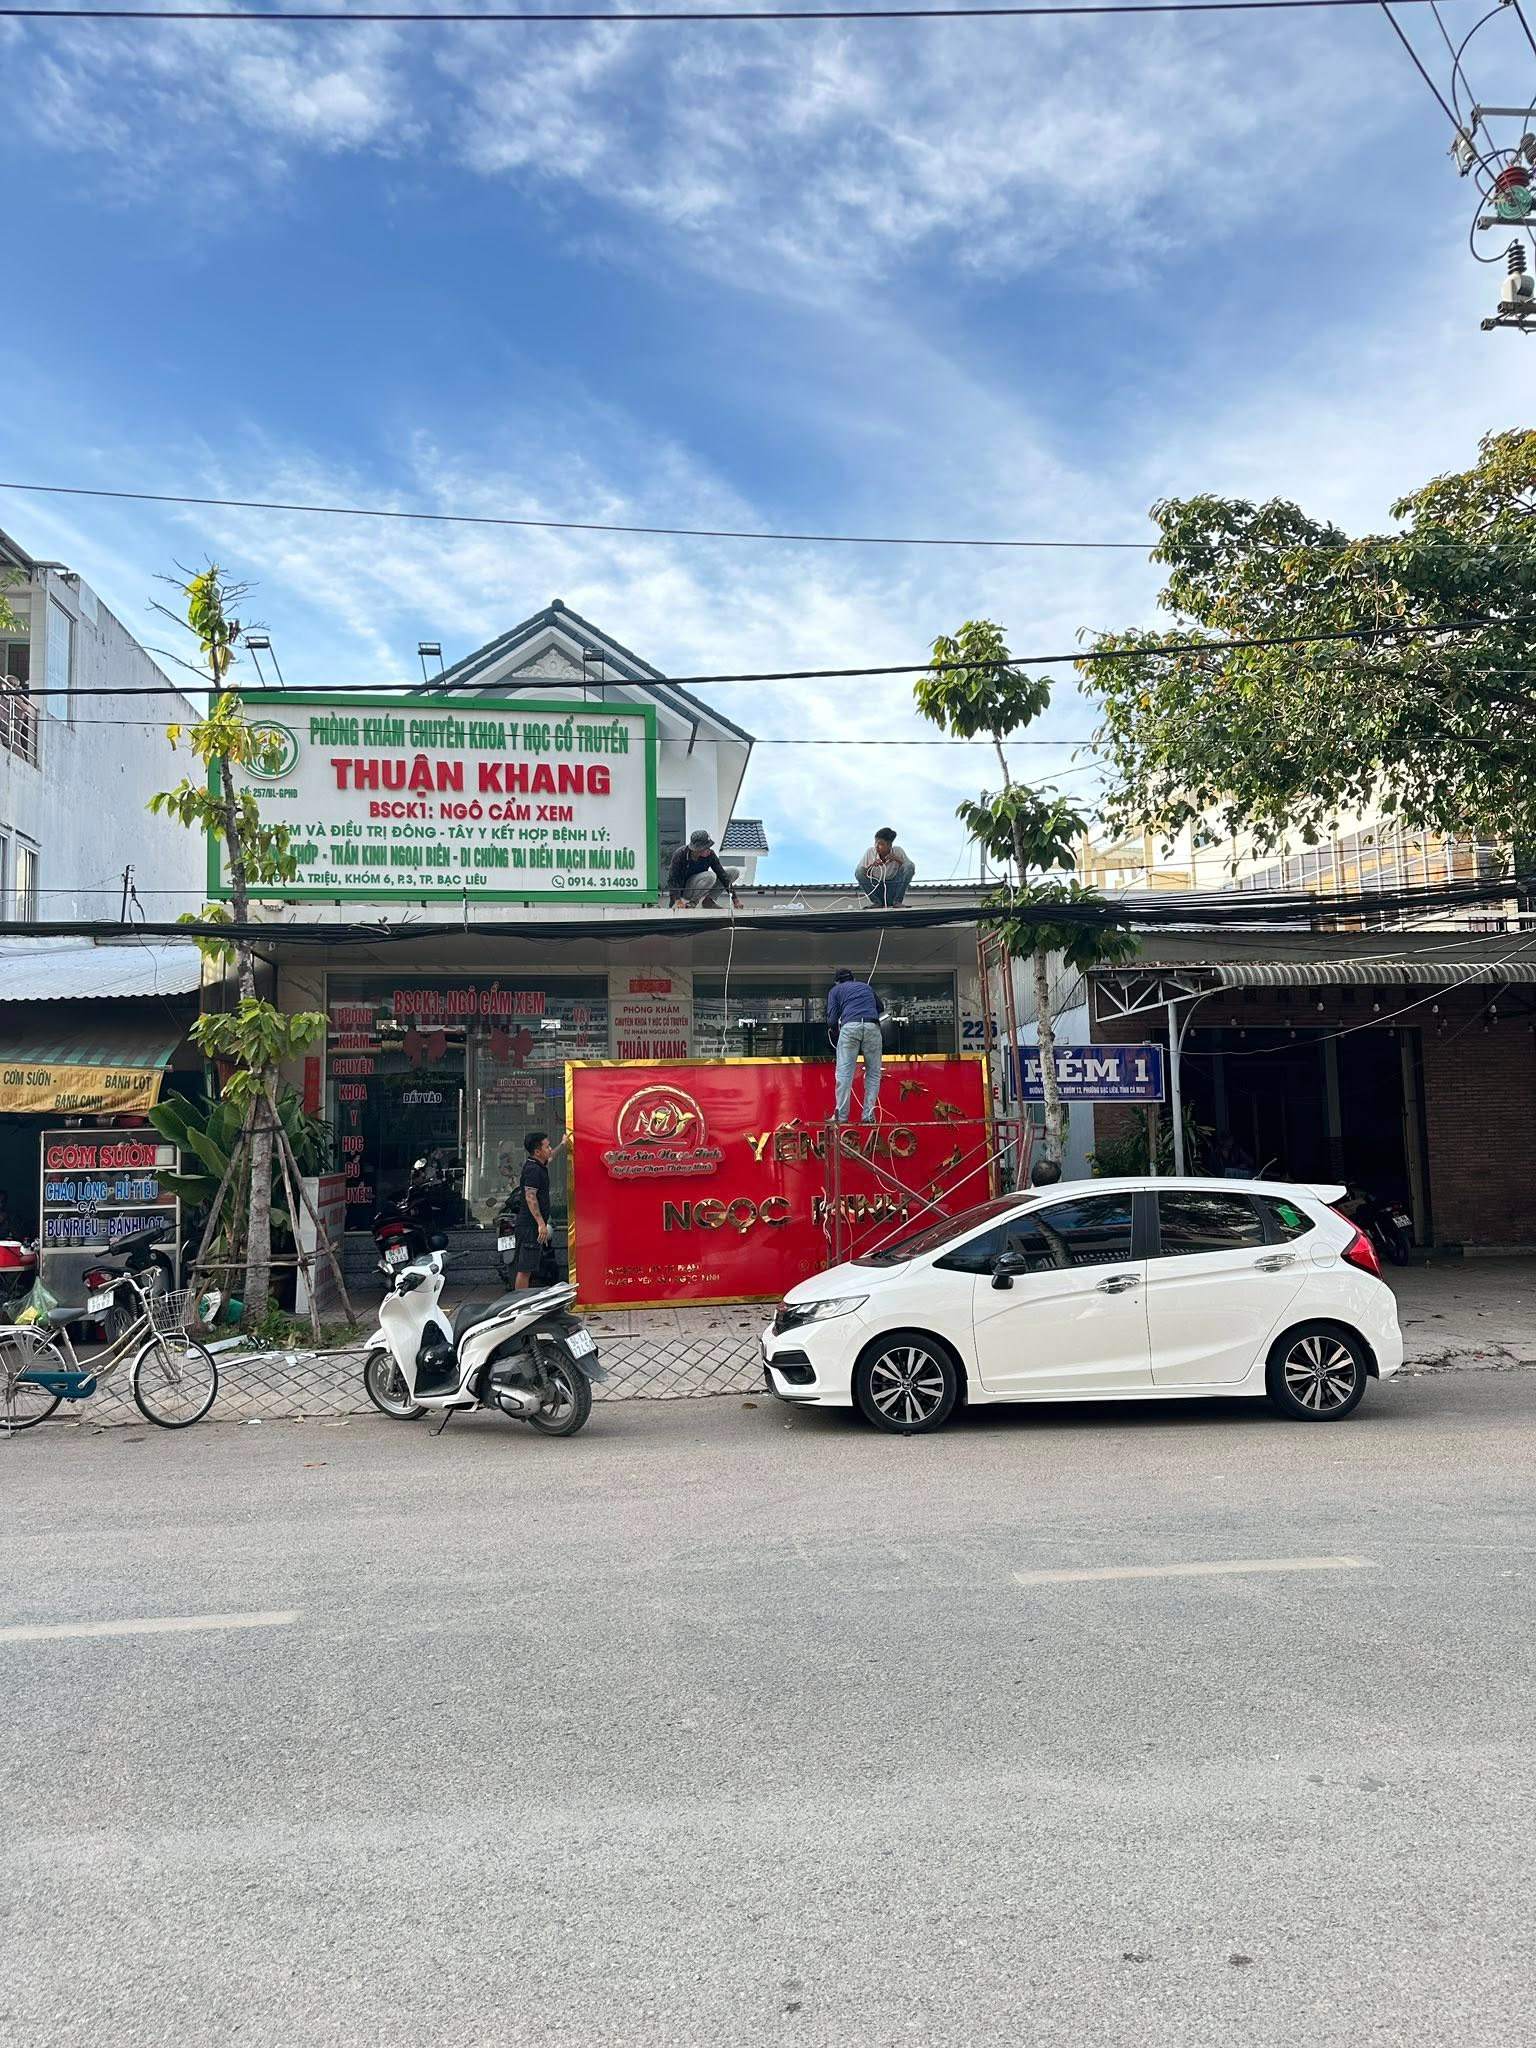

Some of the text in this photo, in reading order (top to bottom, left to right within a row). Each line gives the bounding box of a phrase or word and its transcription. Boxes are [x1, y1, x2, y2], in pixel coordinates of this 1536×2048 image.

[309, 711, 359, 747] PHÒNG
[363, 713, 405, 747] KHÁM
[409, 715, 465, 749] CHUYÊN
[469, 720, 507, 750] KHOA
[510, 722, 519, 750] Y
[523, 723, 550, 755] HỌC
[554, 714, 574, 752] CỔ
[330, 753, 611, 799] THUẬN KHANG
[369, 797, 573, 822] BSCK1: NGÔ CẨM XEM
[306, 821, 326, 836] VÀ
[330, 820, 362, 837] ĐIỀU
[367, 825, 387, 840] TRỊ
[392, 823, 436, 838] ĐÔNG
[448, 824, 474, 839] TÂY
[478, 828, 487, 839] Y
[492, 823, 514, 840] KẾT
[519, 828, 548, 844] HỢP
[553, 826, 587, 844] BỆNH
[592, 826, 610, 842] LÝ:
[362, 846, 387, 866] KINH
[390, 846, 423, 870] NGOẠI
[426, 843, 450, 867] BIÊN
[461, 847, 471, 868] DI
[474, 843, 508, 868] CHỨNG
[512, 848, 526, 868] TAI
[529, 843, 553, 869] BIẾN
[557, 848, 585, 872] MẠCH
[589, 847, 611, 869] MÁU
[308, 870, 341, 887] TRIỆU,
[345, 872, 380, 884] KHÓM
[383, 874, 394, 886] 6,
[419, 874, 433, 884] TP.
[437, 874, 461, 887] BẠC
[466, 872, 487, 885] LIÊU
[567, 877, 638, 888] 0914. 314030
[447, 985, 476, 1015] NGÔ
[515, 991, 545, 1015] XEM
[656, 1004, 680, 1014] KHÁM
[653, 1040, 688, 1059] KHANG
[332, 1056, 374, 1075] CHUYÊN
[1024, 1051, 1149, 1082] HẺM 1
[3, 1069, 24, 1085] CƠM
[26, 1069, 52, 1087] SƯỜN
[105, 1072, 130, 1090] BÁNH
[55, 1090, 78, 1108] BÁNH
[340, 1083, 368, 1101] KHOA
[423, 1090, 443, 1104] VÀO
[350, 1109, 359, 1126] Y
[47, 1138, 158, 1169] CƠM SƯỜN
[342, 1135, 364, 1157] HỌC
[46, 1176, 76, 1201] CHÁO
[77, 1176, 108, 1200] LÒNG
[662, 1196, 793, 1235] NGỌC
